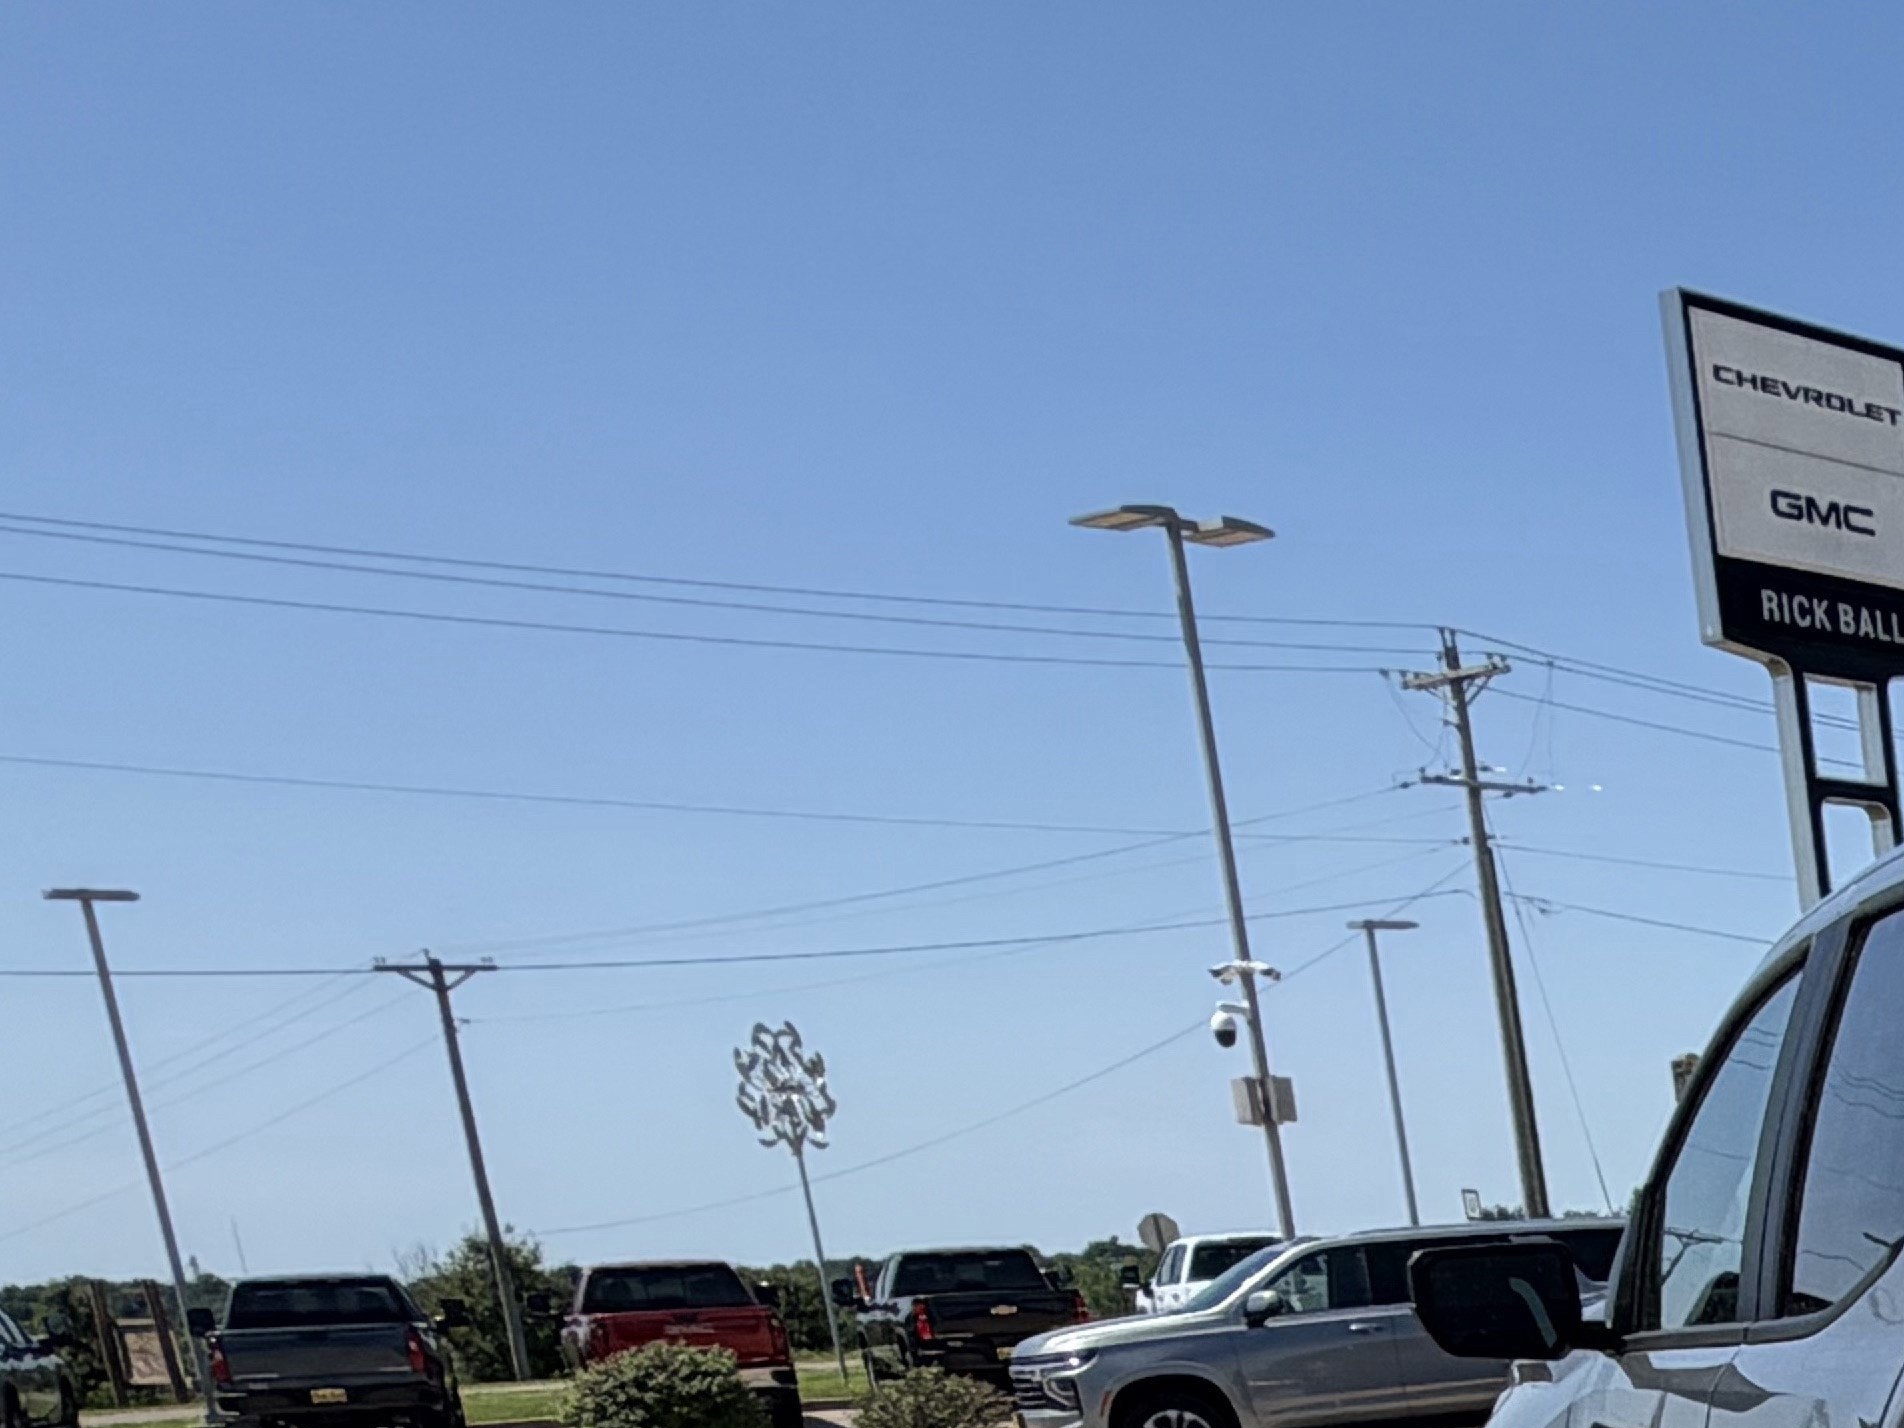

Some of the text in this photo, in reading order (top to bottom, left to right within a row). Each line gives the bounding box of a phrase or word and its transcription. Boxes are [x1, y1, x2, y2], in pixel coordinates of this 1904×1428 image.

[1713, 364, 1901, 426] CHEVROLET
[1770, 488, 1876, 537] GMC
[1760, 588, 1831, 632] RICK
